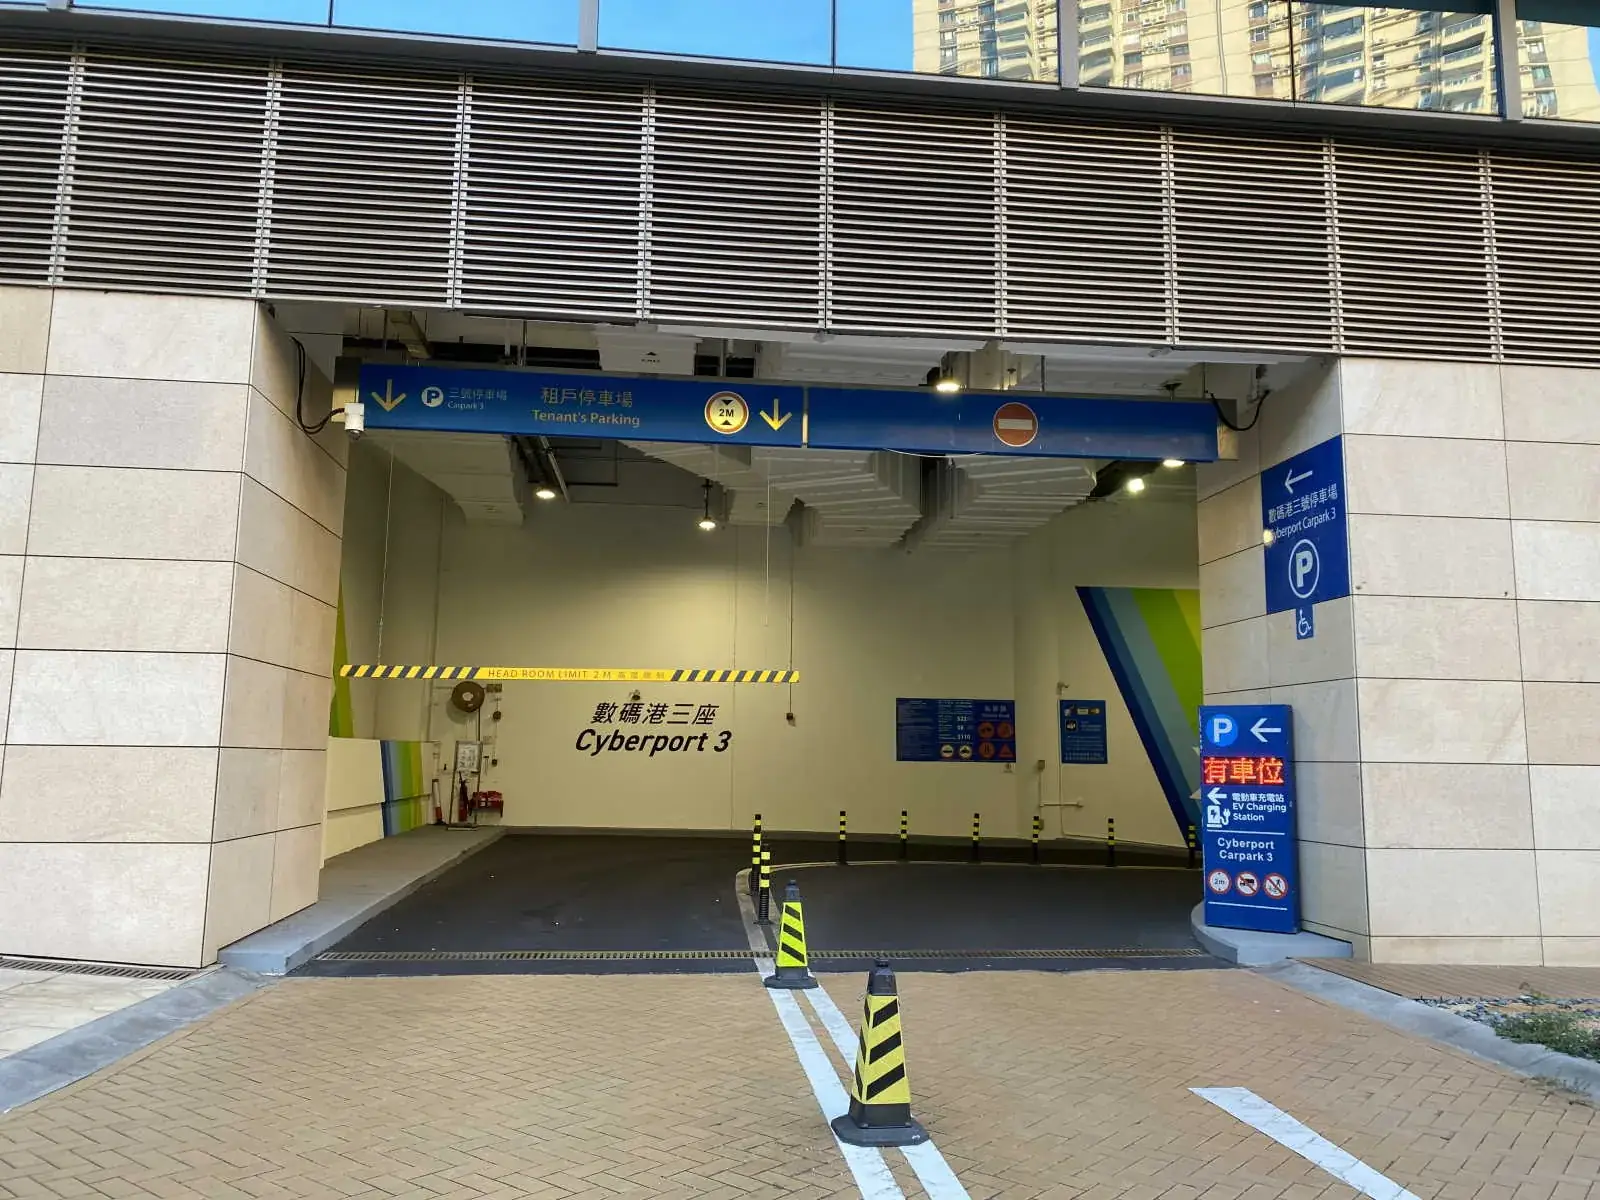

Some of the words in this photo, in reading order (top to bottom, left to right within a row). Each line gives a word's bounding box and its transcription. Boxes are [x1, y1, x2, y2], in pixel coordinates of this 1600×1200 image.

[532, 409, 587, 423] Tenant's
[590, 411, 641, 428] Parking
[719, 408, 734, 417] 2M
[1302, 508, 1331, 529] Carpark
[1330, 506, 1337, 520] 3
[1296, 550, 1314, 588] P
[488, 668, 518, 678] HEAD
[521, 669, 554, 679] ROOM
[558, 669, 587, 679] LIMIT
[590, 702, 720, 725] 數碼港三座
[1213, 718, 1233, 743] P
[575, 728, 709, 757] Cyberport
[713, 730, 732, 752] 3
[1203, 757, 1284, 784] 有車位
[1232, 802, 1245, 811] EV
[1246, 802, 1287, 813] Charging
[1232, 812, 1265, 822] Station
[1217, 837, 1275, 850] Cyberport
[1219, 850, 1264, 862] Carpark
[1266, 852, 1274, 862] 3
[1214, 877, 1225, 885] 2m
